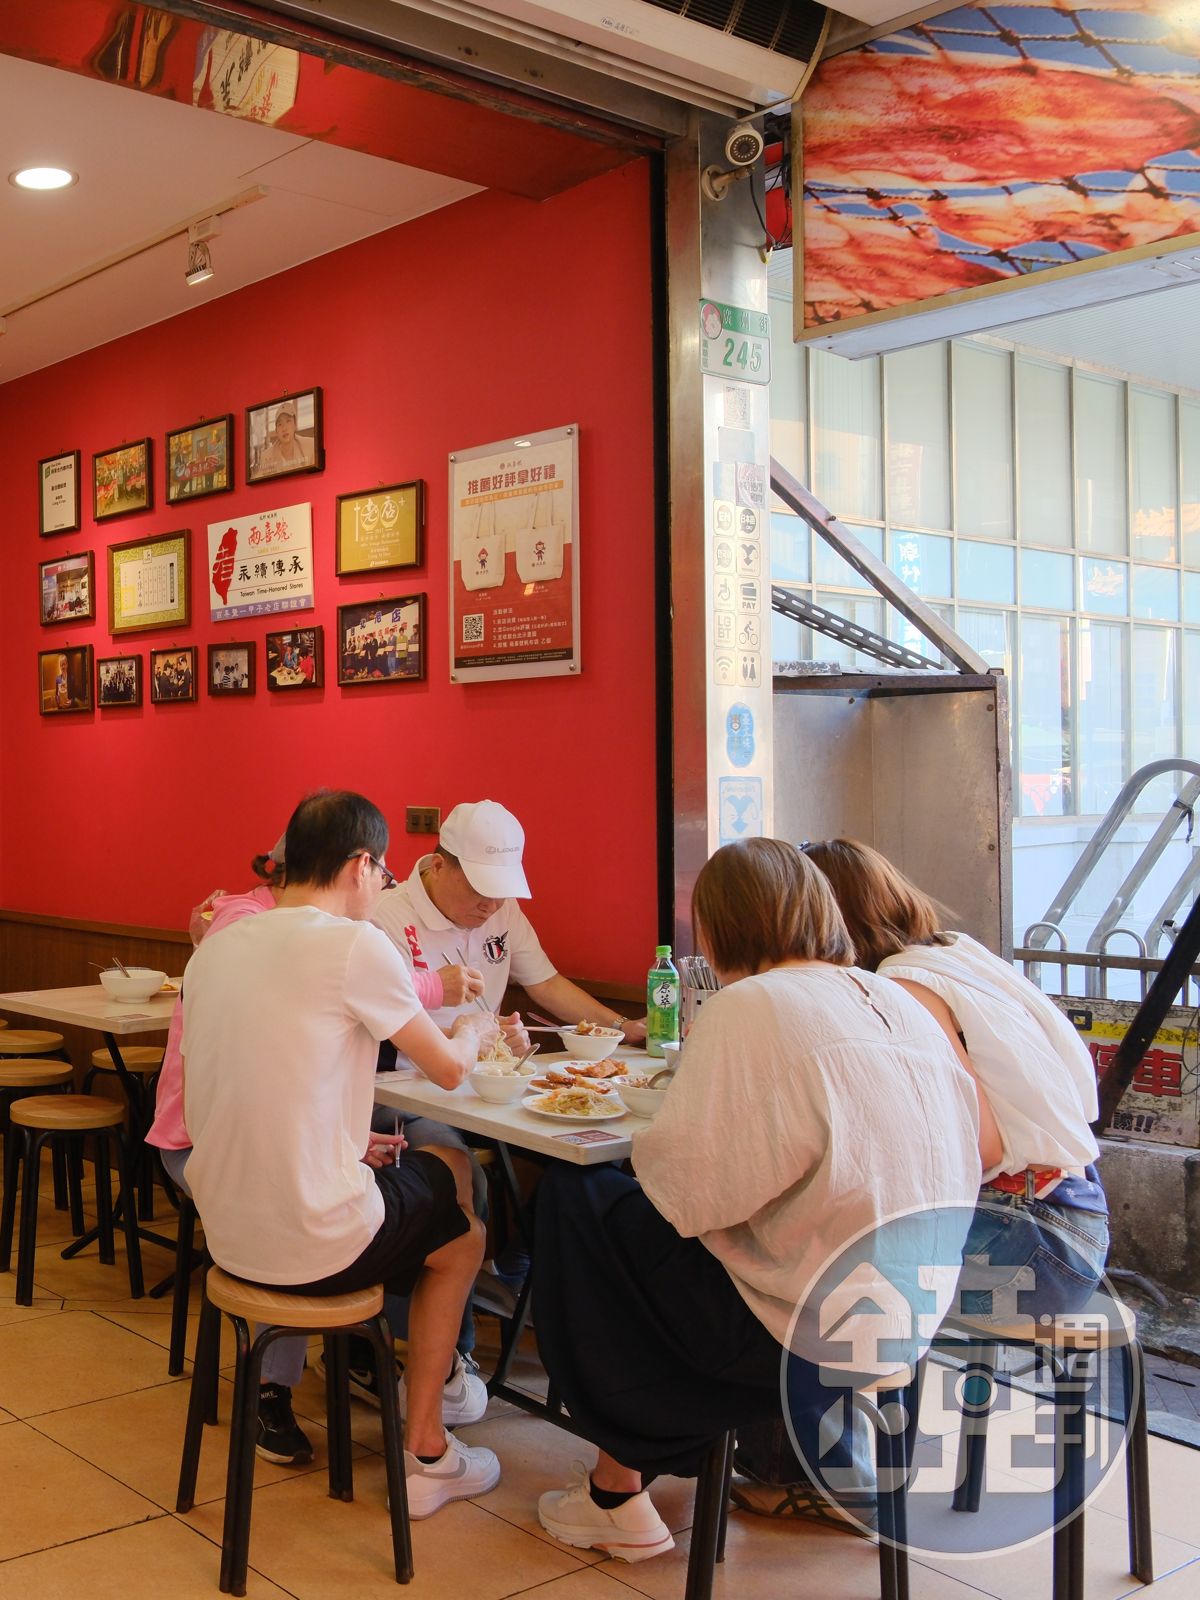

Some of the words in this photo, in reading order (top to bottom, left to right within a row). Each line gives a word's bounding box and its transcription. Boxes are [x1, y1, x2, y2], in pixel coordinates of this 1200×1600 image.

[722, 308, 768, 334] 廣州街
[723, 338, 762, 373] 245
[248, 518, 290, 546] 兩喜號
[238, 555, 304, 582] 永續傳承
[257, 584, 288, 594] Time-Honored
[289, 582, 304, 591] Stores
[742, 602, 756, 610] PAY
